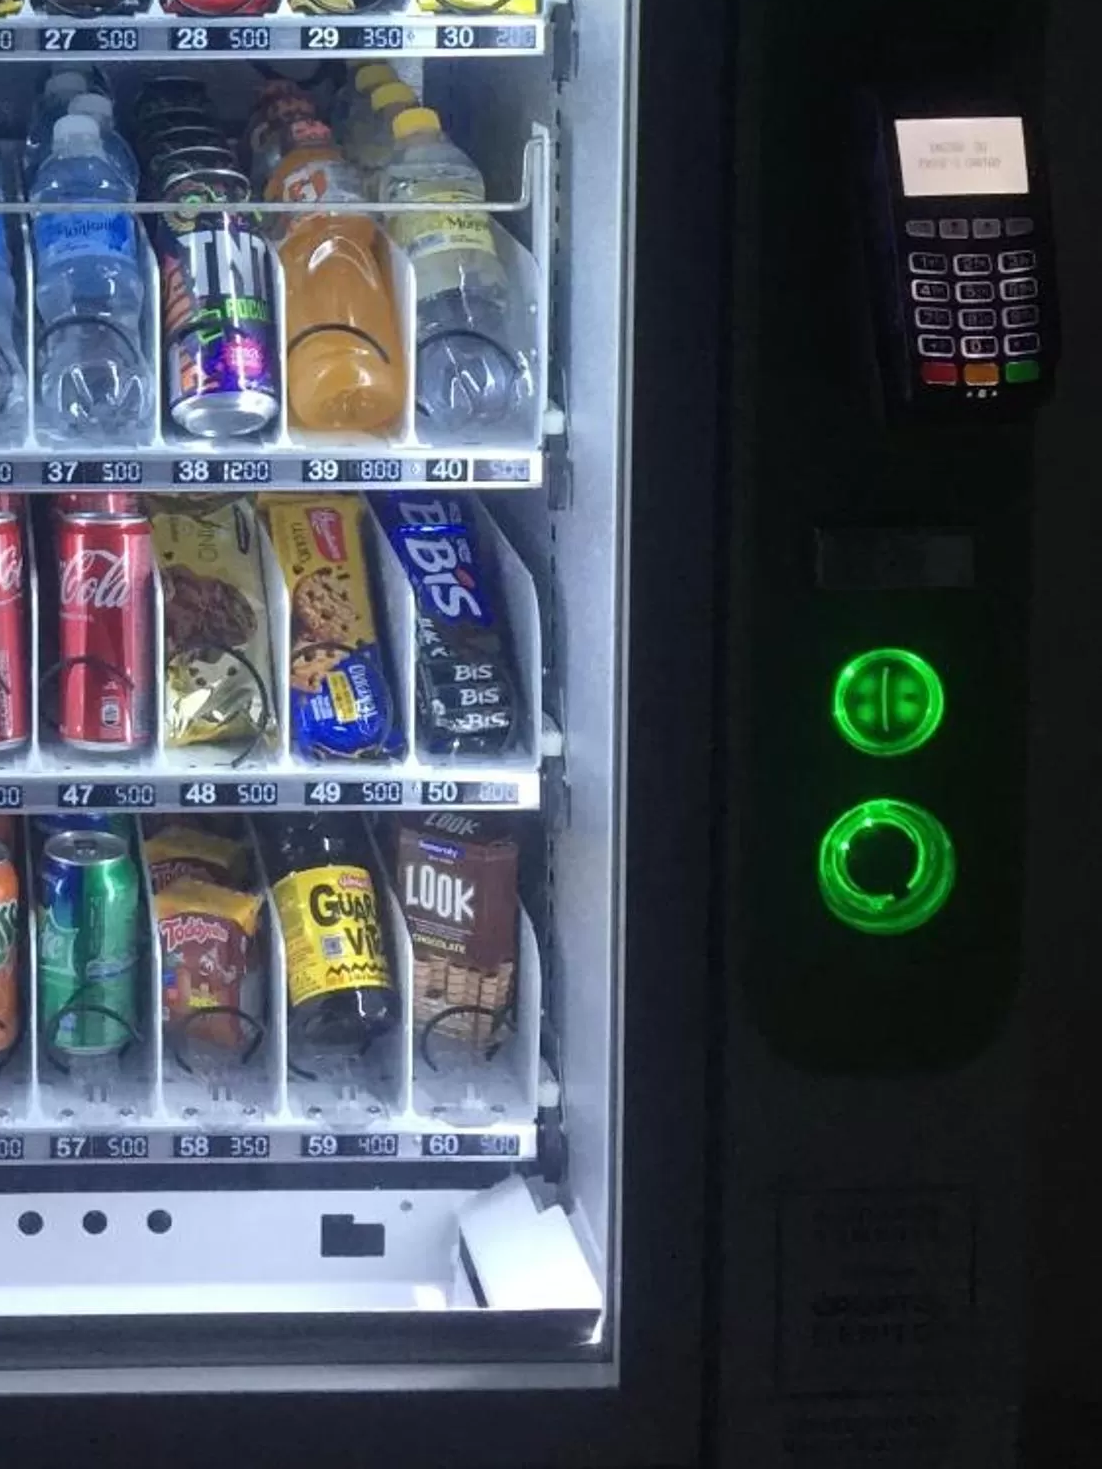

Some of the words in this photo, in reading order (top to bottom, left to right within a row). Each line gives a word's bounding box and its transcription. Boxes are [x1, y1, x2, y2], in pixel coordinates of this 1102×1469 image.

[45, 29, 76, 49] 27
[177, 28, 208, 49] 28
[308, 27, 339, 48] 29
[443, 27, 474, 47] 30
[177, 229, 269, 298] TNT
[48, 462, 78, 482] 37
[179, 461, 209, 481] 38
[309, 460, 338, 480] 39
[432, 459, 462, 479] 40
[62, 785, 93, 805] 47
[185, 783, 216, 803] 48
[310, 781, 341, 803] 49
[428, 781, 457, 802] 50
[405, 864, 475, 922] LOOK
[56, 1137, 85, 1157] 57
[180, 1136, 209, 1156] 58
[308, 1134, 337, 1155] 59
[428, 1134, 458, 1155] 60
